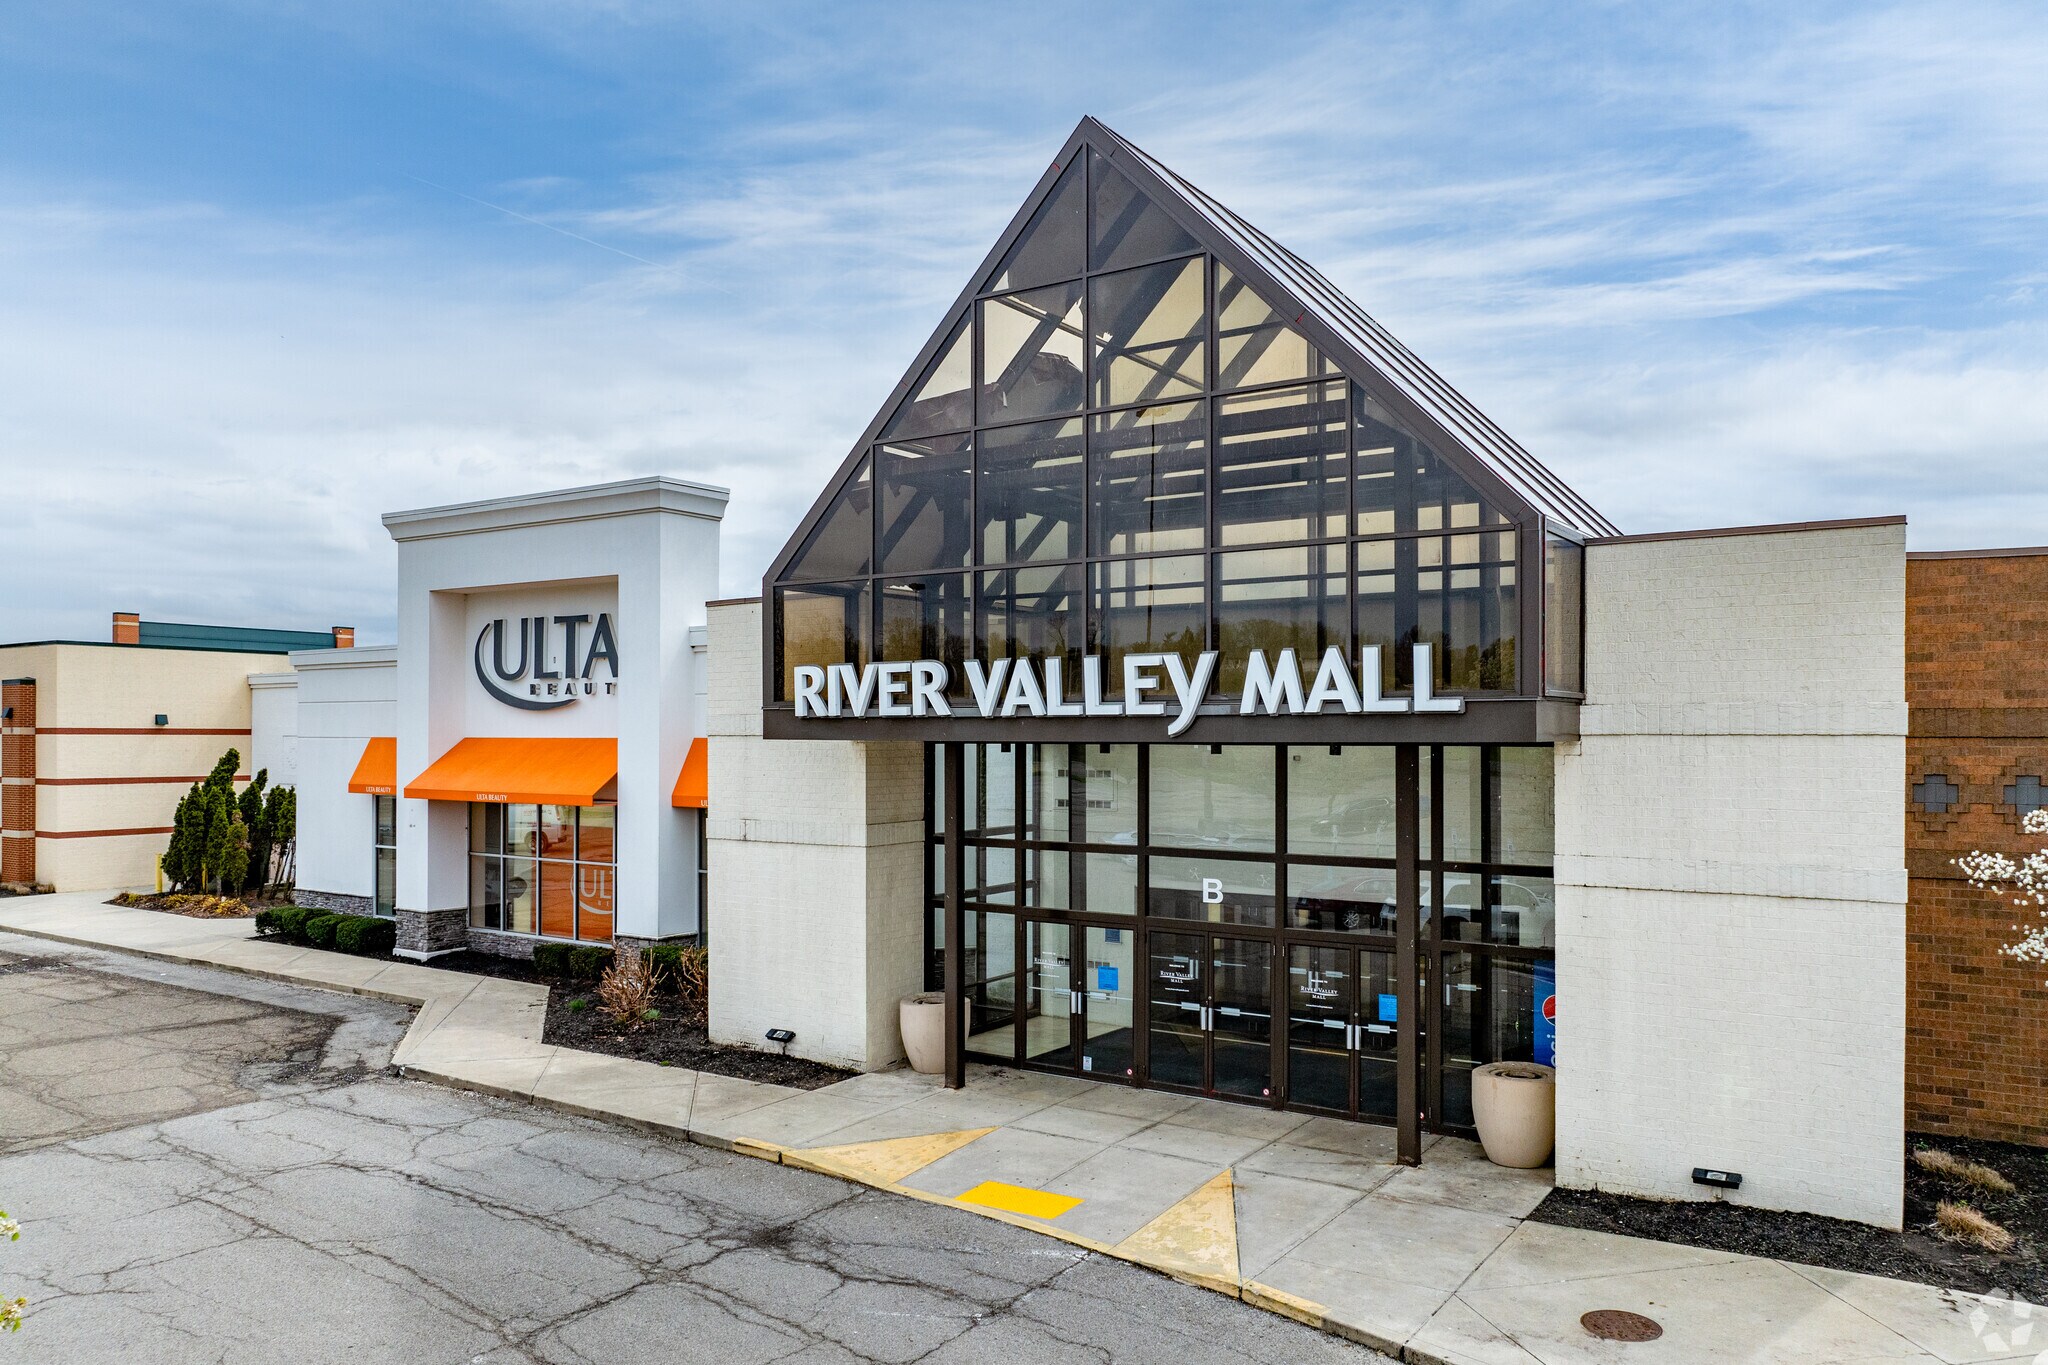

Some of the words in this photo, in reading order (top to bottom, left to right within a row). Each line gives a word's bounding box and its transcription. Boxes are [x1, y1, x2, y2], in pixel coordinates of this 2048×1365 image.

[494, 613, 618, 681] ULTA
[530, 682, 617, 696] BEAUT
[794, 659, 953, 718] RIVER
[1240, 643, 1466, 716] MALL
[488, 794, 507, 802] BEAUTY
[1202, 877, 1224, 904] B
